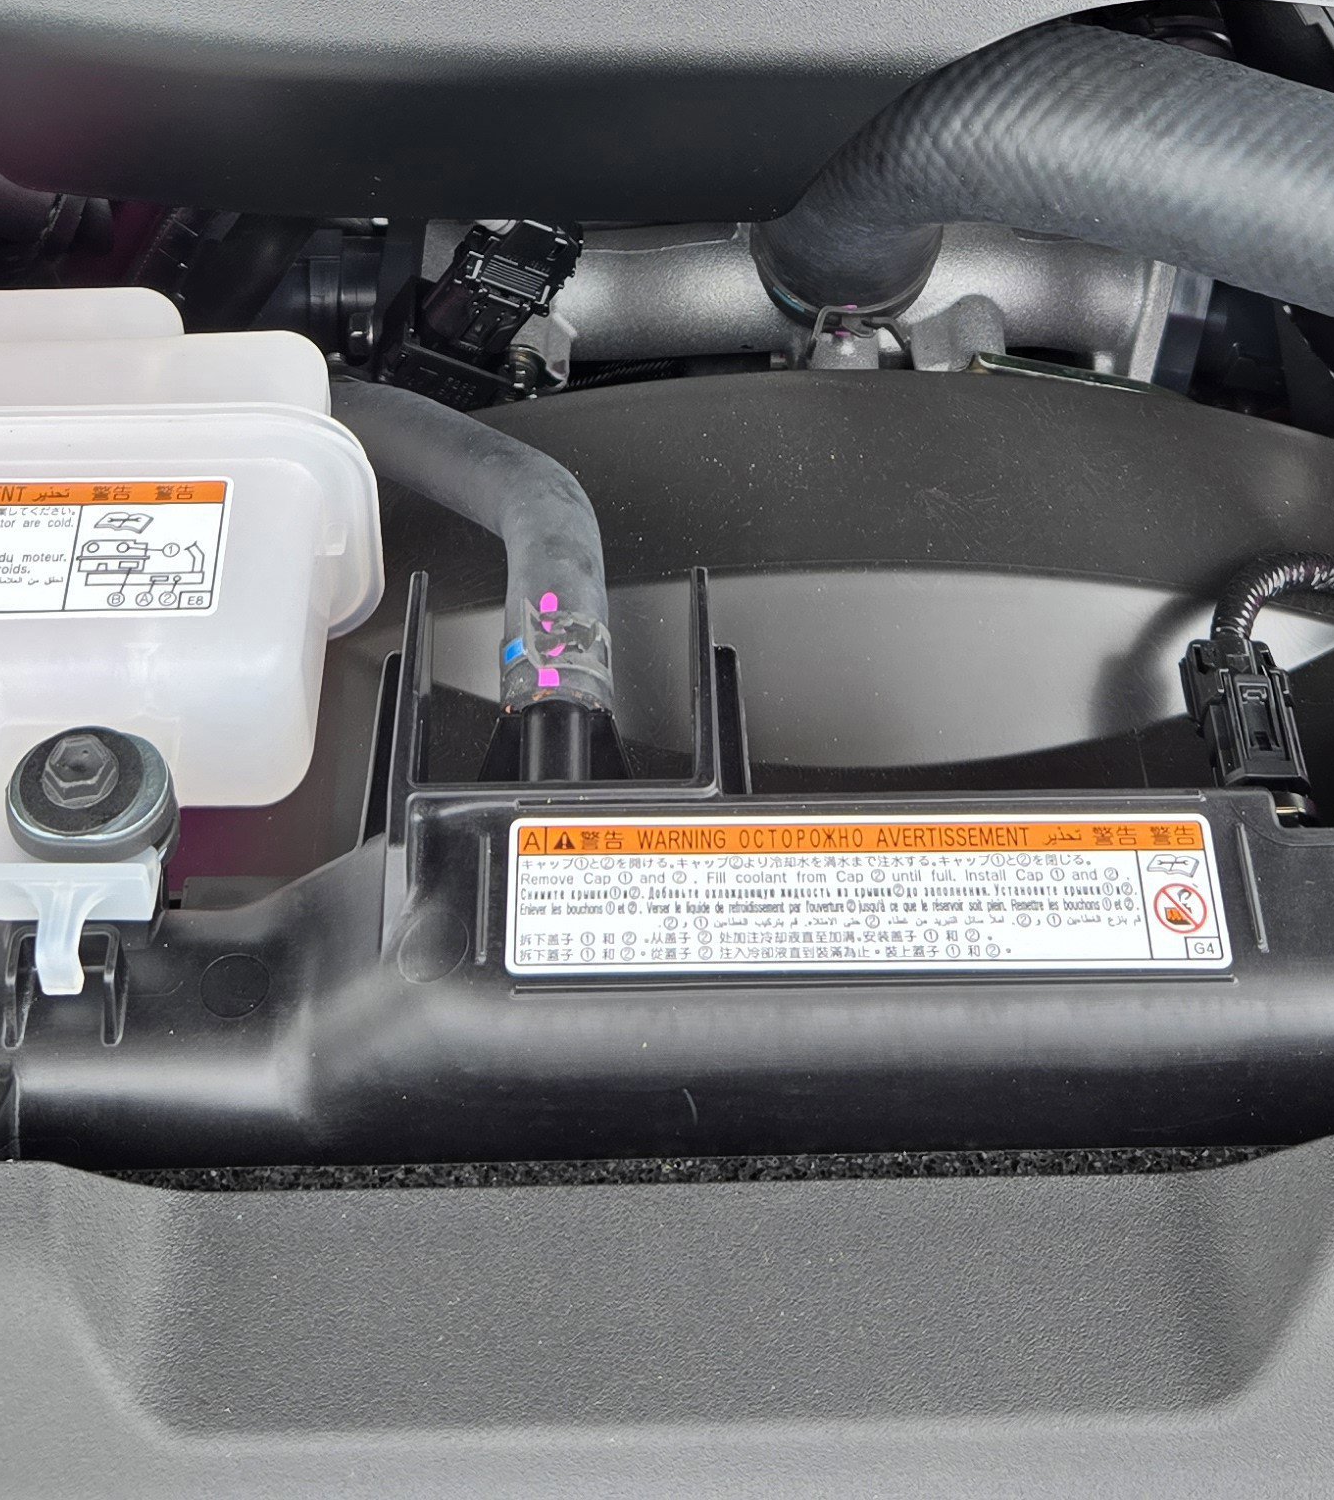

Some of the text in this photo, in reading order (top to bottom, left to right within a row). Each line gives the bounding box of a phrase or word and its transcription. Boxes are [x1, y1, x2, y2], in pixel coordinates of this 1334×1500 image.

[31, 486, 69, 502] تحذير
[91, 485, 129, 501] 警告
[154, 485, 192, 500] 警告
[22, 519, 41, 527] are
[47, 516, 73, 527] cold.
[21, 552, 66, 562] moteur.
[186, 595, 203, 604] E8
[522, 825, 1194, 851] A 警告 WARNING ОСТОРОЖНО AVERTISSEMENT تحذير 警告 警告
[520, 873, 573, 885] Remove
[583, 872, 611, 885] Cap
[639, 871, 665, 883] and
[706, 871, 726, 884] Fill
[735, 870, 787, 883] coolant
[796, 870, 826, 883] from
[835, 870, 863, 883] Cap
[891, 869, 921, 882] until
[931, 868, 956, 881] full.
[964, 868, 1006, 881] Install
[1015, 868, 1043, 881] Cap
[1071, 868, 1097, 880] and
[1193, 941, 1214, 954] G4
